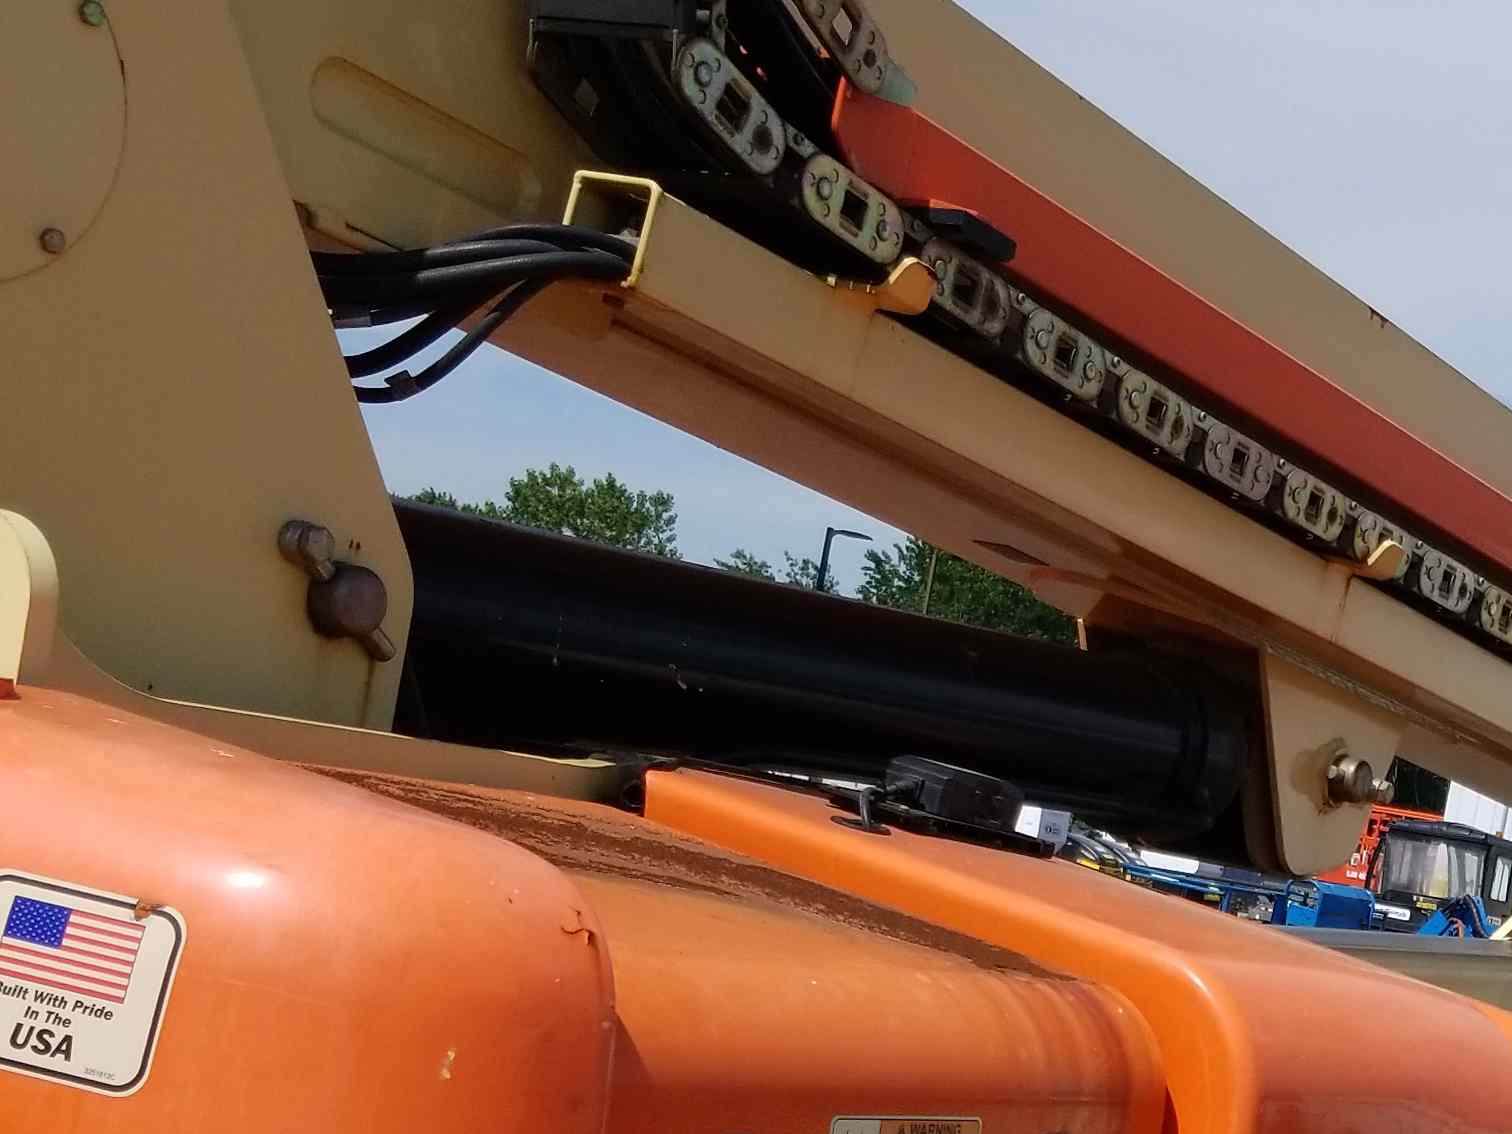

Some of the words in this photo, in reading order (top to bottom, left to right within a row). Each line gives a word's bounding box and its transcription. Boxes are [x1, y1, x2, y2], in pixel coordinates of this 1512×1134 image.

[24, 1006, 40, 1020] In
[45, 1010, 72, 1028] The
[34, 990, 68, 1010] With
[72, 1000, 114, 1021] Pride
[9, 1022, 73, 1062] USA
